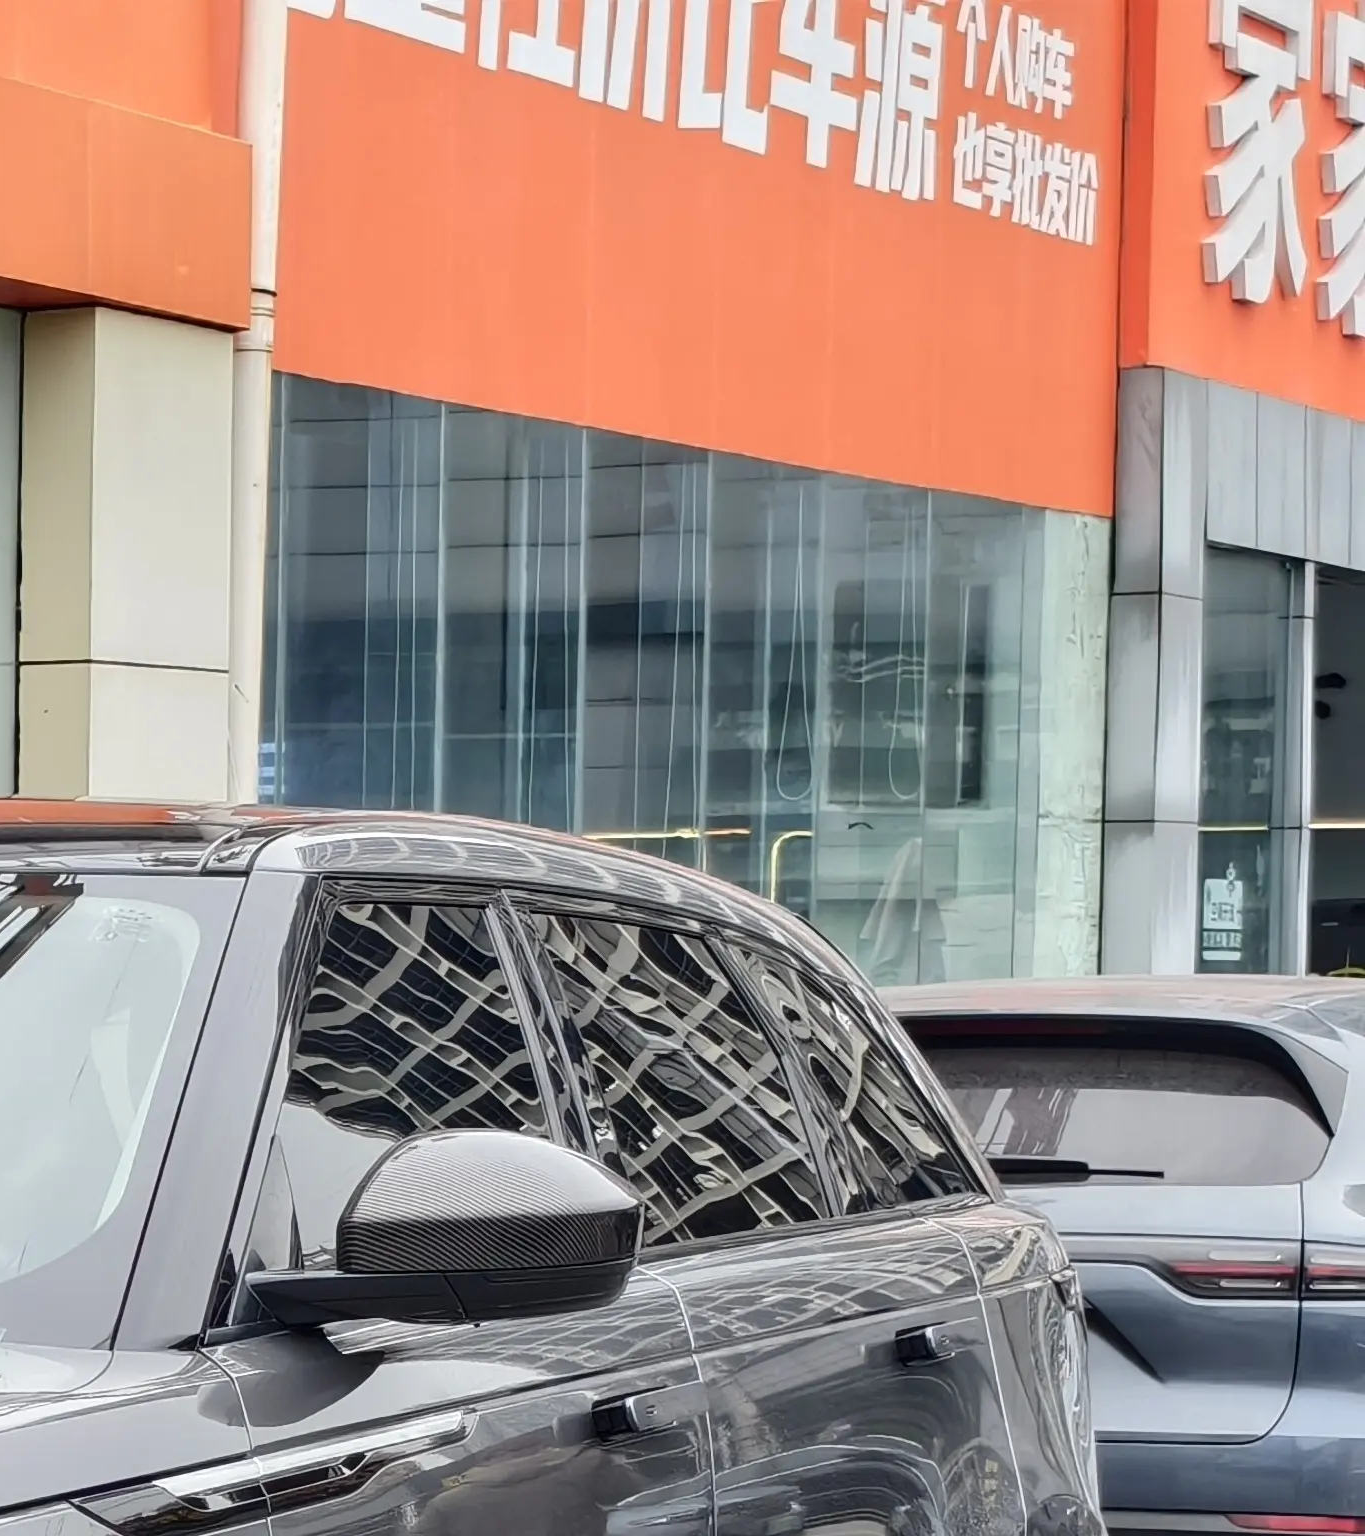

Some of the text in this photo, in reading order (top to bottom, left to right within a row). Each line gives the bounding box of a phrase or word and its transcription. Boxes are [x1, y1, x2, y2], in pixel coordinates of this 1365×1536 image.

[957, 0, 1075, 119] 个人购车
[953, 112, 1099, 246] 也享批发价
